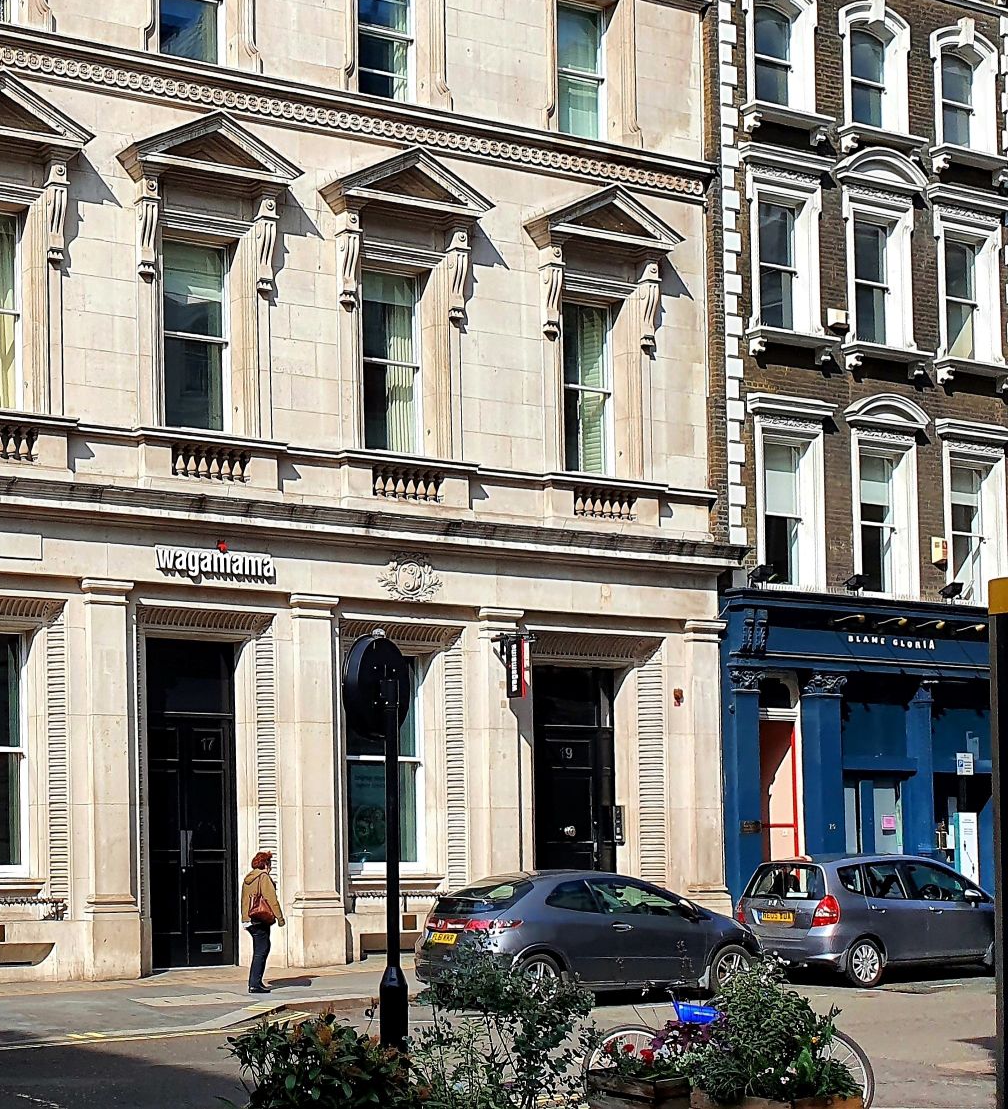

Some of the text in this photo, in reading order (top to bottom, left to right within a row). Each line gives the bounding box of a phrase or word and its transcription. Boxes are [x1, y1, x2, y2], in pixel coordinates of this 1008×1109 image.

[155, 546, 274, 577] wagamama
[848, 635, 935, 650] BLAME GLORIA
[201, 737, 216, 751] 17
[560, 747, 573, 759] 19
